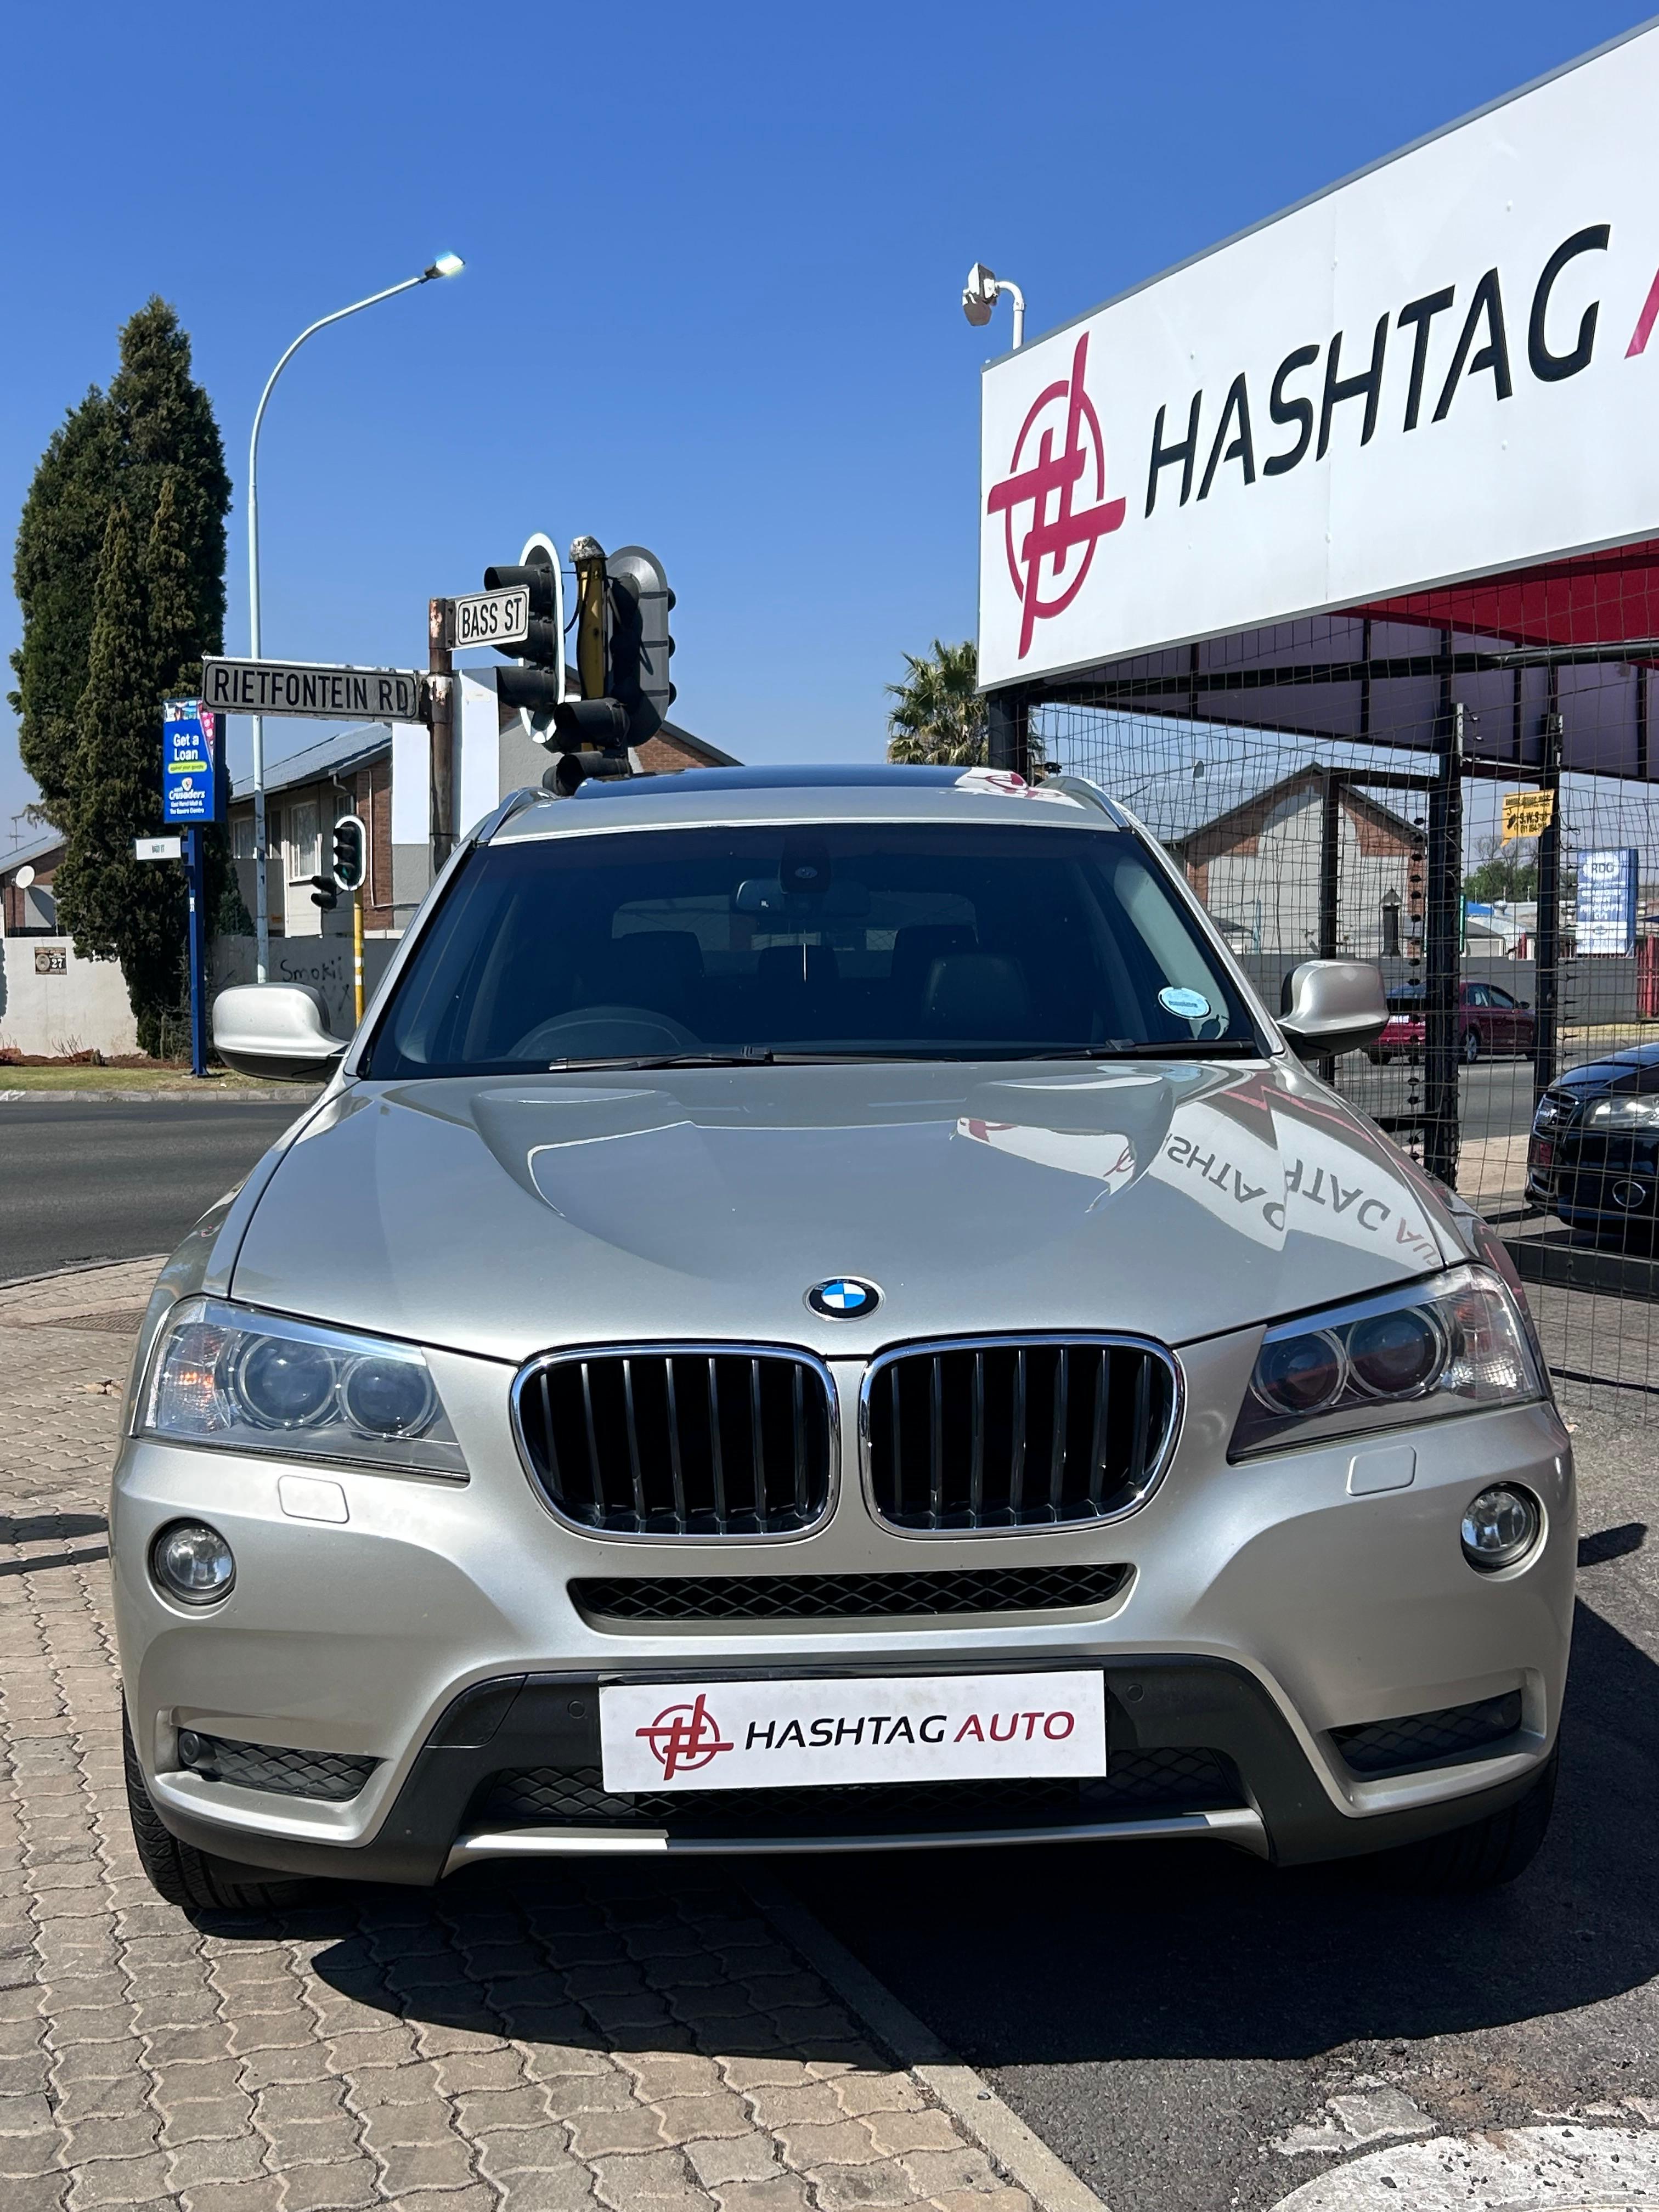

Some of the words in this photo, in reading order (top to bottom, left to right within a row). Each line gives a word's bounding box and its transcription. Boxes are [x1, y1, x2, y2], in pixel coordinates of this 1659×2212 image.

[1144, 223, 1611, 519] HASHTAG
[462, 602, 498, 639] BASS
[505, 597, 522, 631] ST
[215, 668, 368, 710] RIETFONTEIN
[379, 679, 408, 712] RD
[173, 733, 190, 747] Get
[192, 735, 199, 746] a
[174, 748, 198, 761] Loan
[52, 958, 63, 968] 27
[745, 1714, 947, 1750] HASHTAG
[954, 1711, 1075, 1742] AUTO
